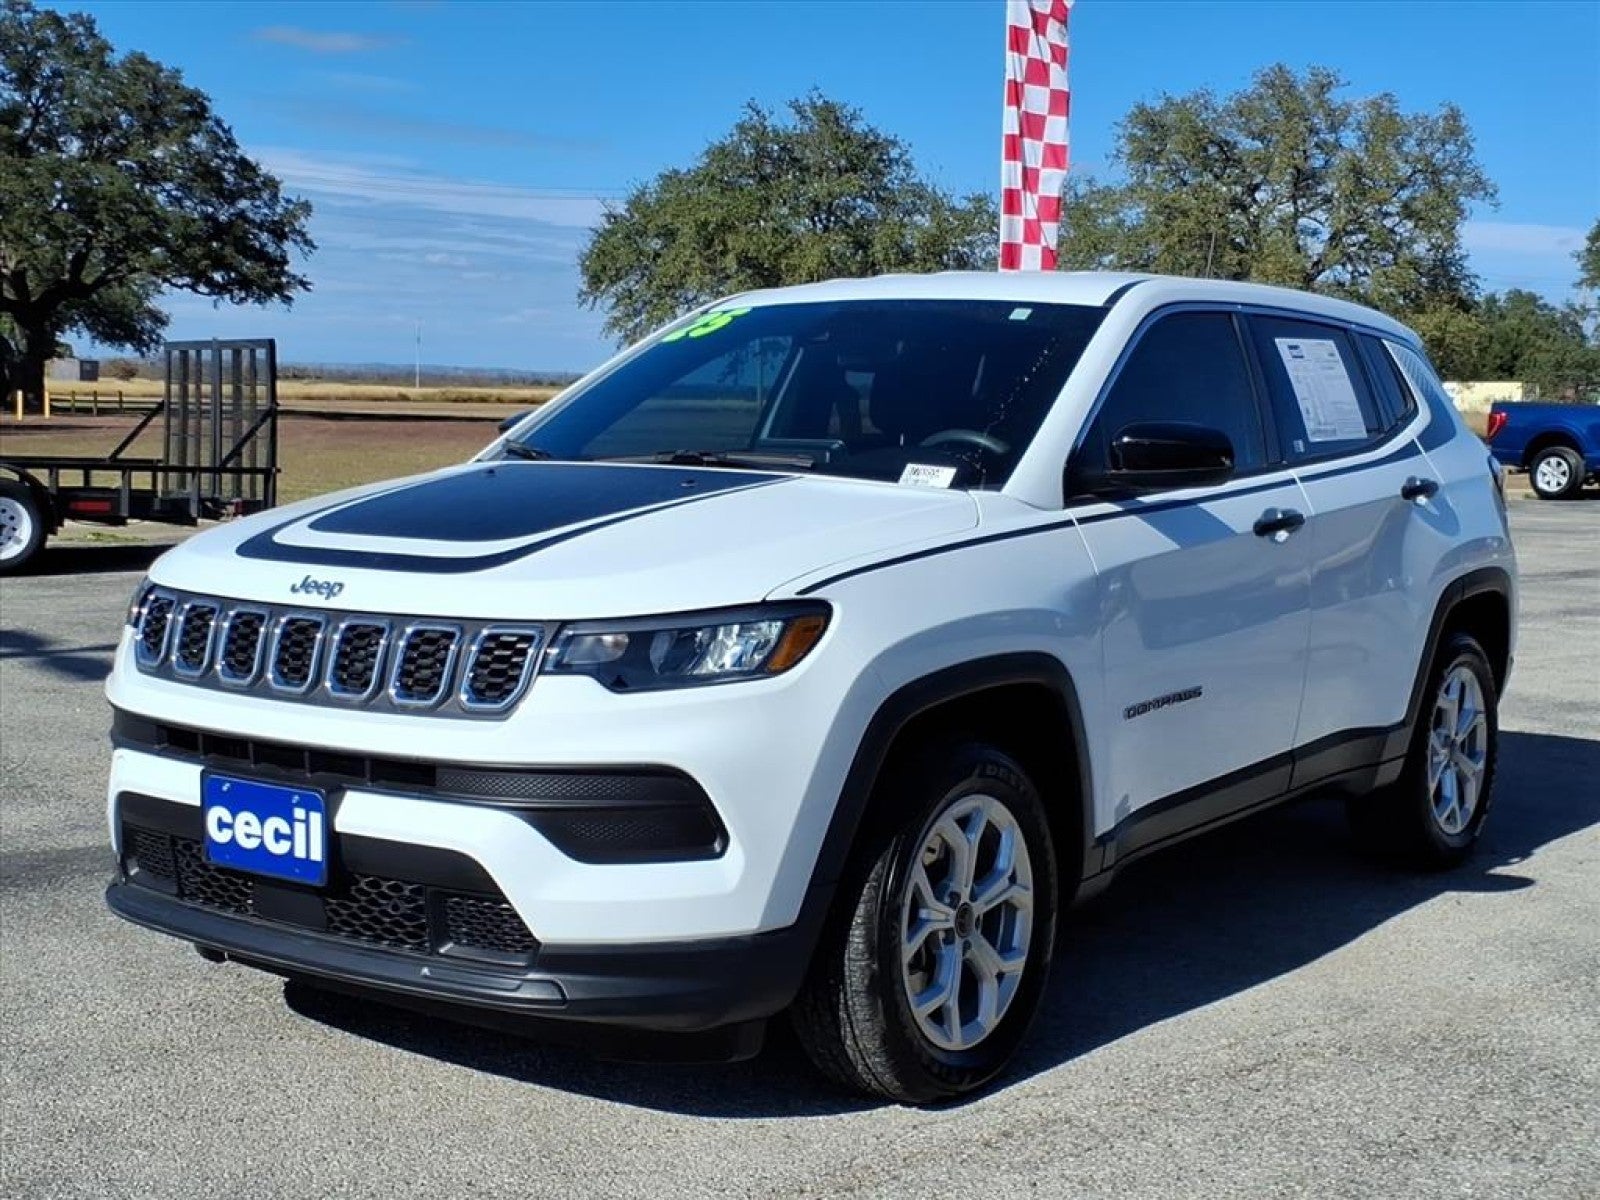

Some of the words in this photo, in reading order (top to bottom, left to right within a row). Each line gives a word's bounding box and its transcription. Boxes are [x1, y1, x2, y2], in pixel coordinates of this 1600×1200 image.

[290, 574, 344, 600] Jeep
[1123, 685, 1203, 721] COMPASS
[207, 805, 323, 861] cecil
